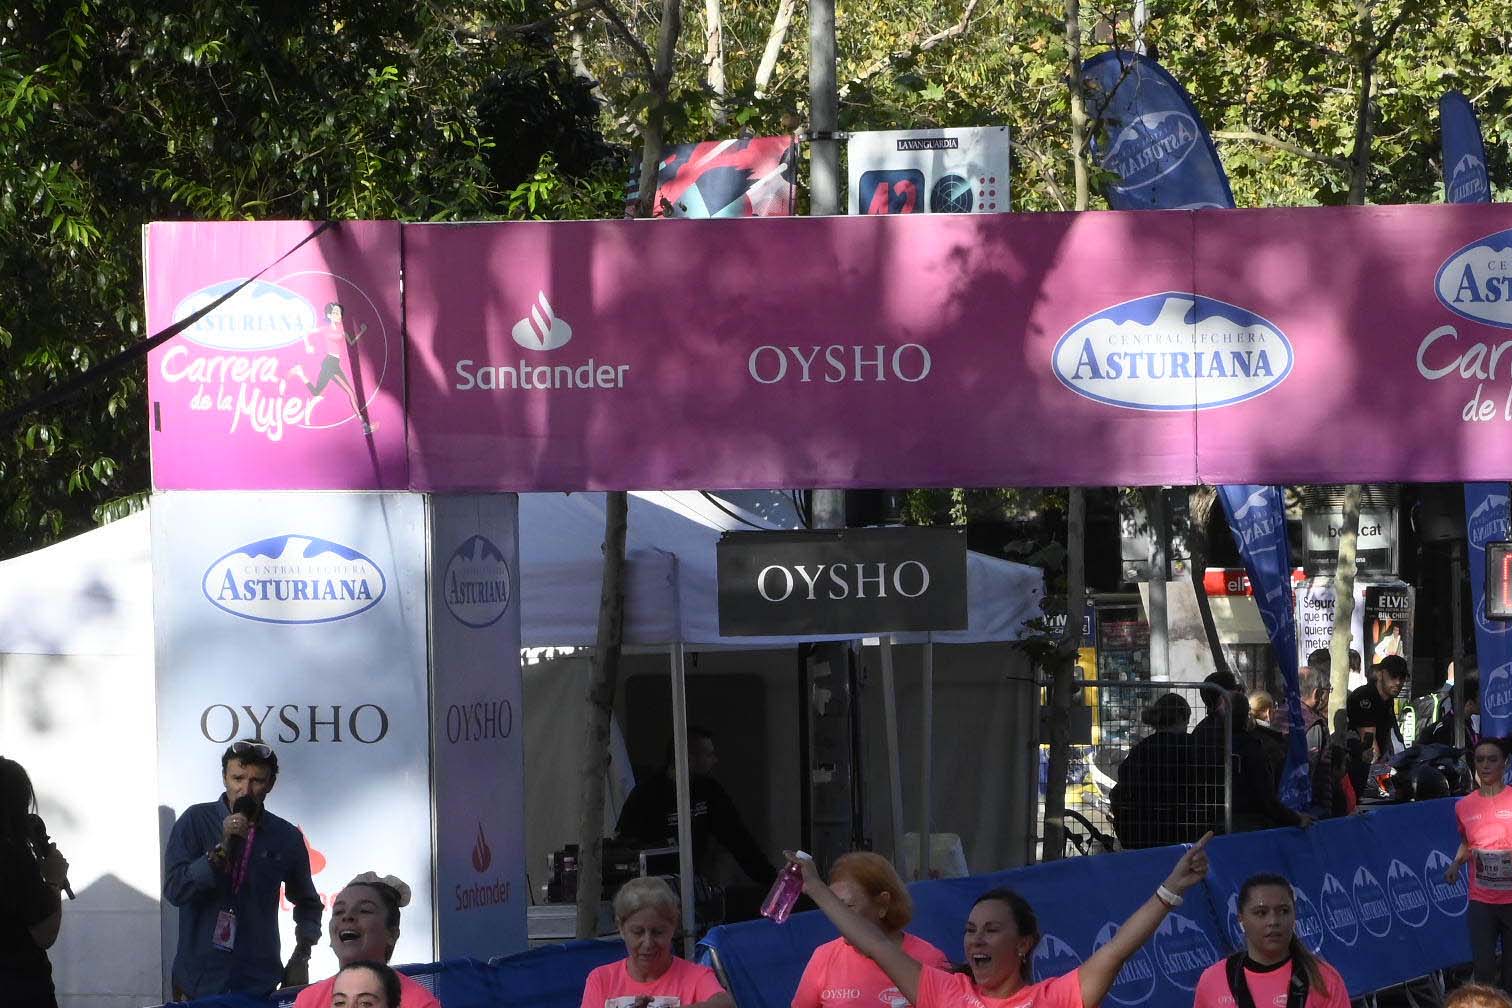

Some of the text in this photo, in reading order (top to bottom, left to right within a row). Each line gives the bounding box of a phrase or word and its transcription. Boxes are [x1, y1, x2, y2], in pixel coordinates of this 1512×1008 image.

[1108, 331, 1267, 346] CENTRAL LECHERA
[161, 346, 280, 383] Carrera
[456, 360, 630, 390] Santander
[748, 343, 931, 384] OYSHO
[1072, 337, 1274, 381] ASTURIANA
[191, 378, 324, 441] de la Mujer
[1462, 384, 1496, 423] de
[217, 567, 373, 601] ASTURIANA
[450, 575, 506, 605] ASTURIANA
[757, 561, 930, 602] OYSHO
[1304, 612, 1320, 625] que
[1379, 595, 1409, 608] ELVIS
[200, 703, 389, 744] OYSHO
[446, 700, 513, 745] OYSHO
[455, 881, 512, 912] Santander
[822, 989, 860, 1000] OYSHO
